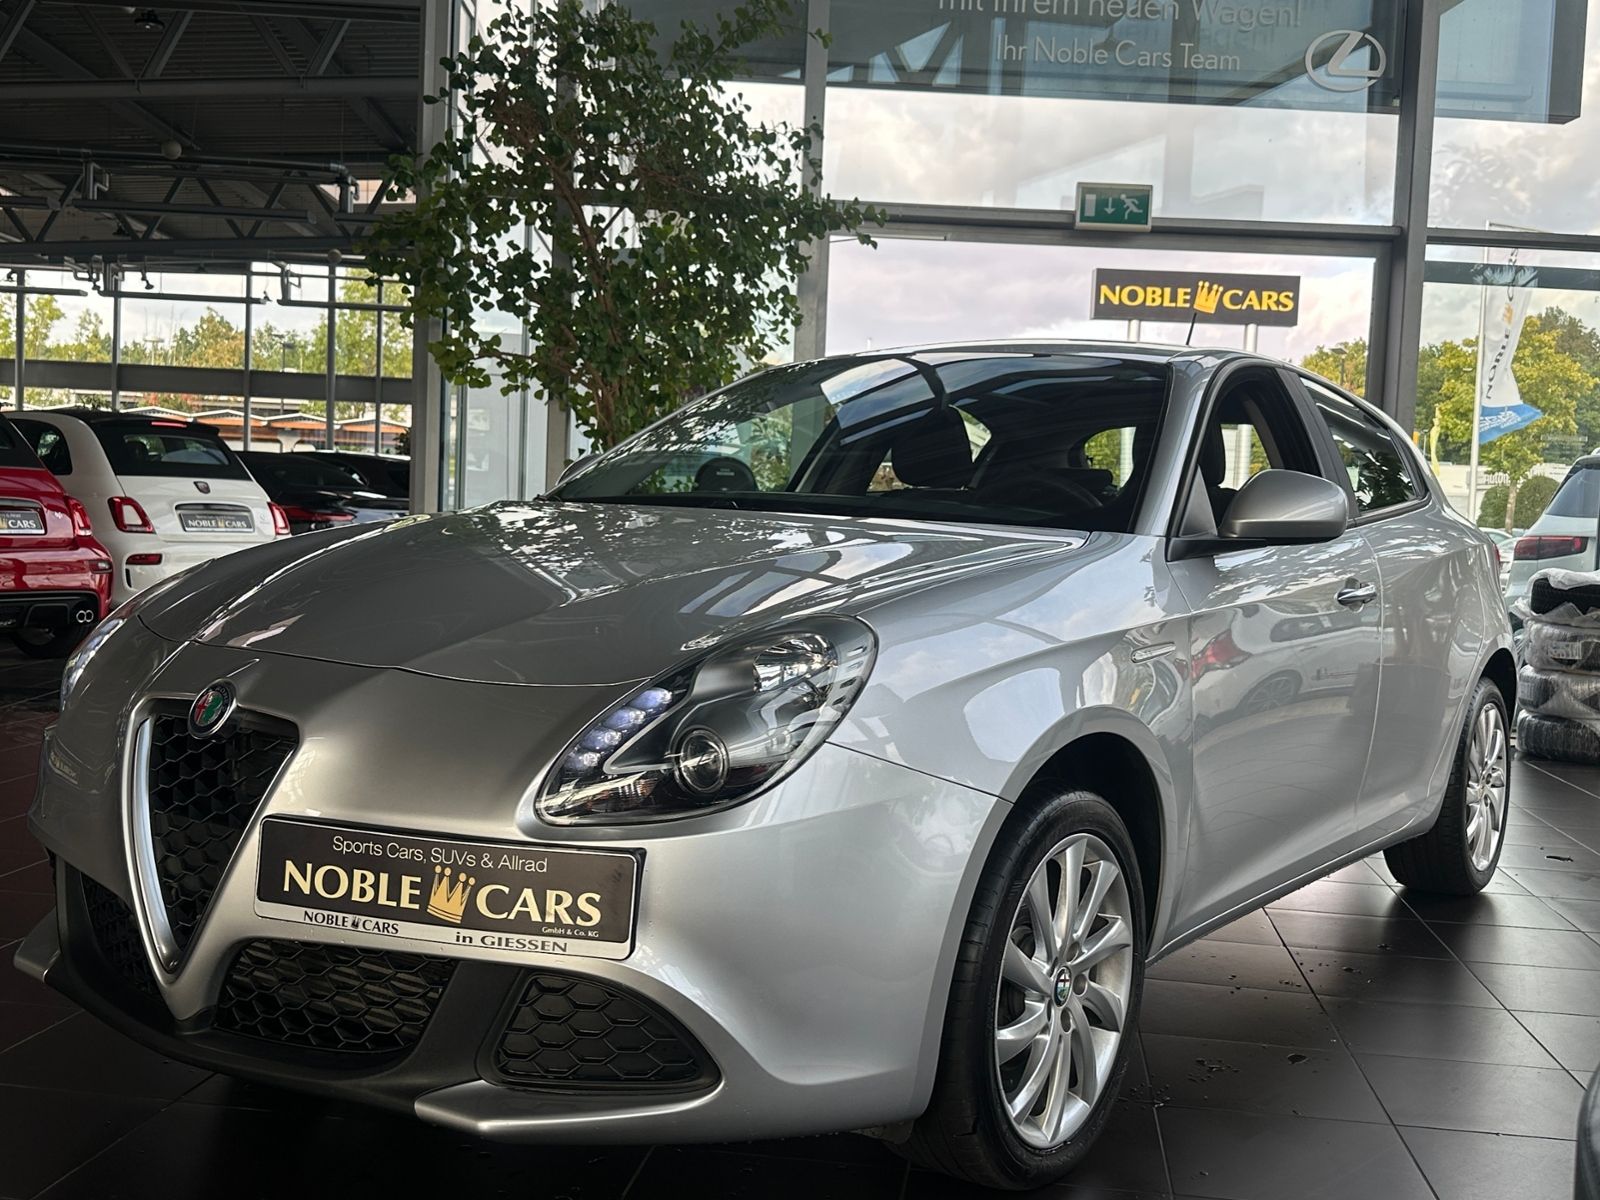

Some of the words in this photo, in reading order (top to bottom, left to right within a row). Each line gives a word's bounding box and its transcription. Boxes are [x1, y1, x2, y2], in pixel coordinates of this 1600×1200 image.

[1191, 0, 1302, 31] Wagen!
[996, 34, 1027, 61] Ihr
[1035, 36, 1108, 65] Noble
[1115, 39, 1172, 67] Cars
[1180, 42, 1240, 71] Team
[1099, 284, 1192, 308] NOBLE
[1222, 289, 1295, 312] CARS
[8, 520, 36, 528] CARS
[188, 519, 217, 527] NOBLE
[225, 520, 247, 528] CARS
[332, 835, 383, 859] Sports
[386, 842, 428, 864] Cars,
[430, 847, 477, 867] SUVs
[481, 853, 493, 869] &
[497, 852, 548, 873] Allrad
[282, 859, 422, 910] NOBLE
[476, 884, 602, 927] CARS
[303, 910, 349, 929] NOBLE
[362, 918, 400, 935] CARS
[541, 926, 565, 936] GmbH
[573, 929, 586, 937] Co.
[587, 930, 599, 938] KG
[455, 931, 474, 945] in
[480, 935, 568, 953] GIESSEN
